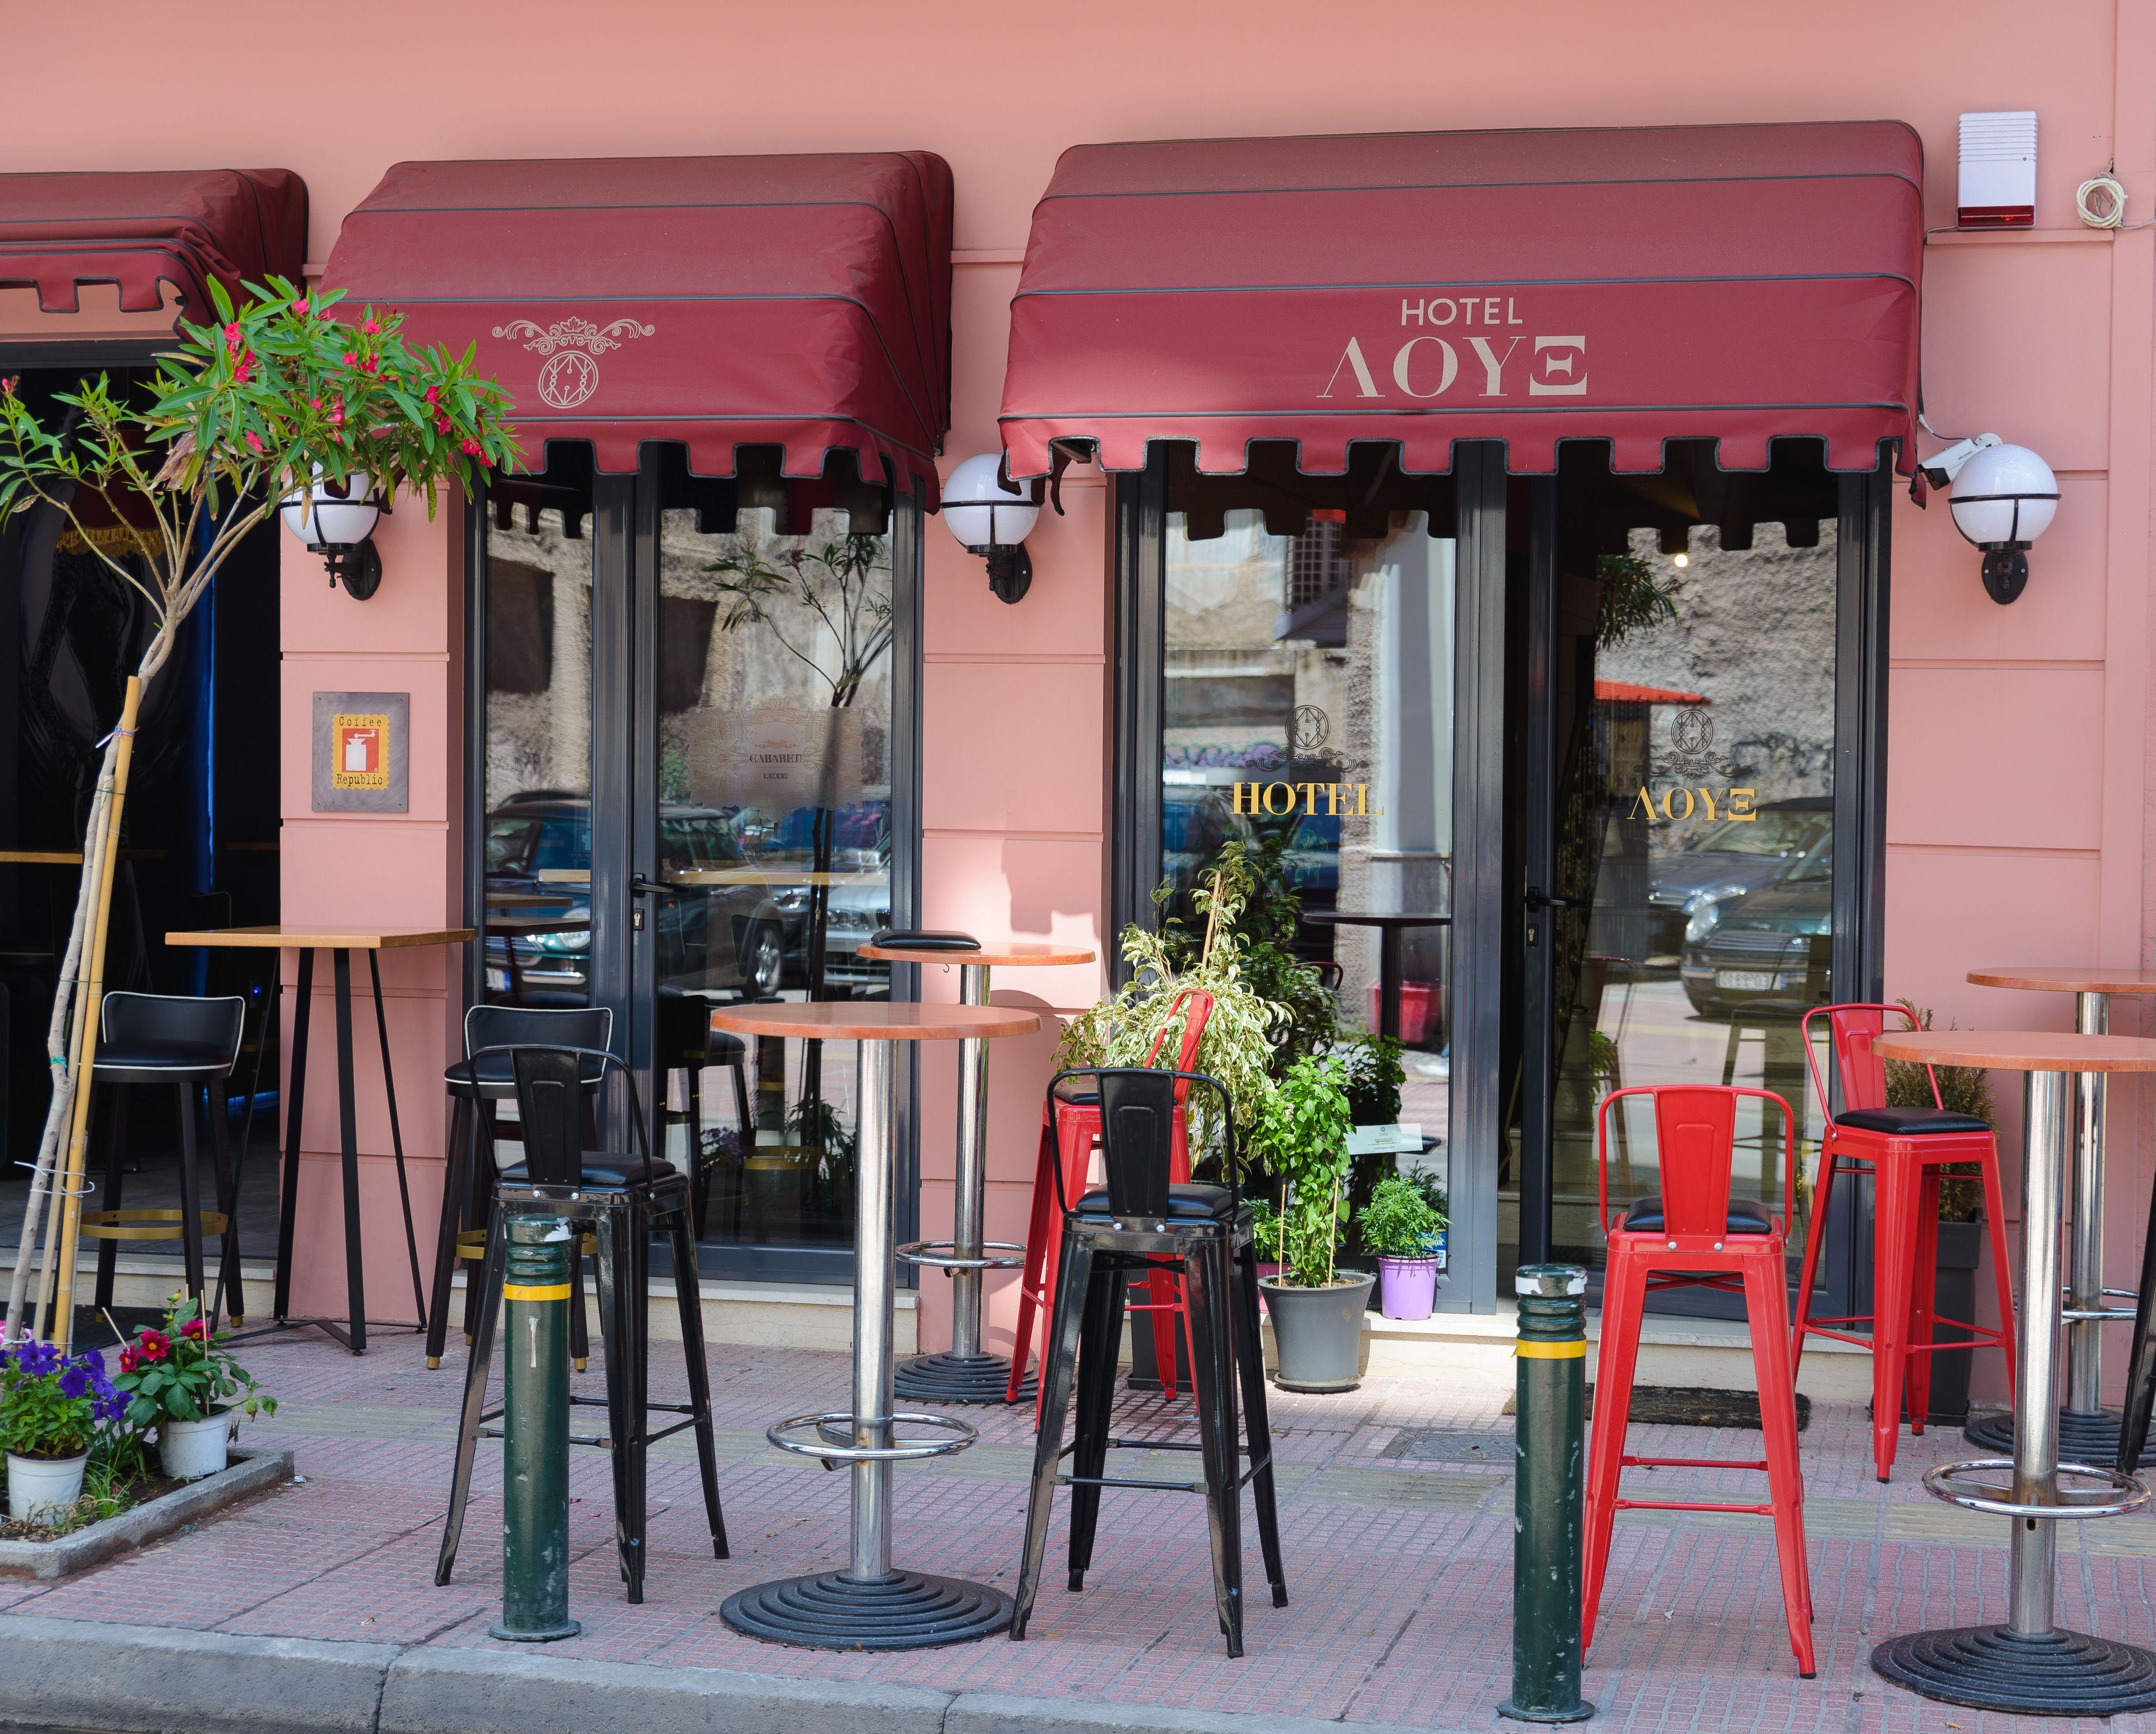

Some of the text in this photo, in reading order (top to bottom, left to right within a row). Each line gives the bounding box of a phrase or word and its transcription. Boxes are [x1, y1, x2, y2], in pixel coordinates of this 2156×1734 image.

[1401, 297, 1523, 326] HOTEL
[1316, 335, 1588, 398] ΛΟΥΞ
[339, 716, 382, 727] Coffee
[749, 754, 801, 763] CABARET
[336, 774, 383, 787] Republic
[1230, 781, 1384, 816] HOTEL
[1627, 786, 1757, 821] ΛΟΥΞ
